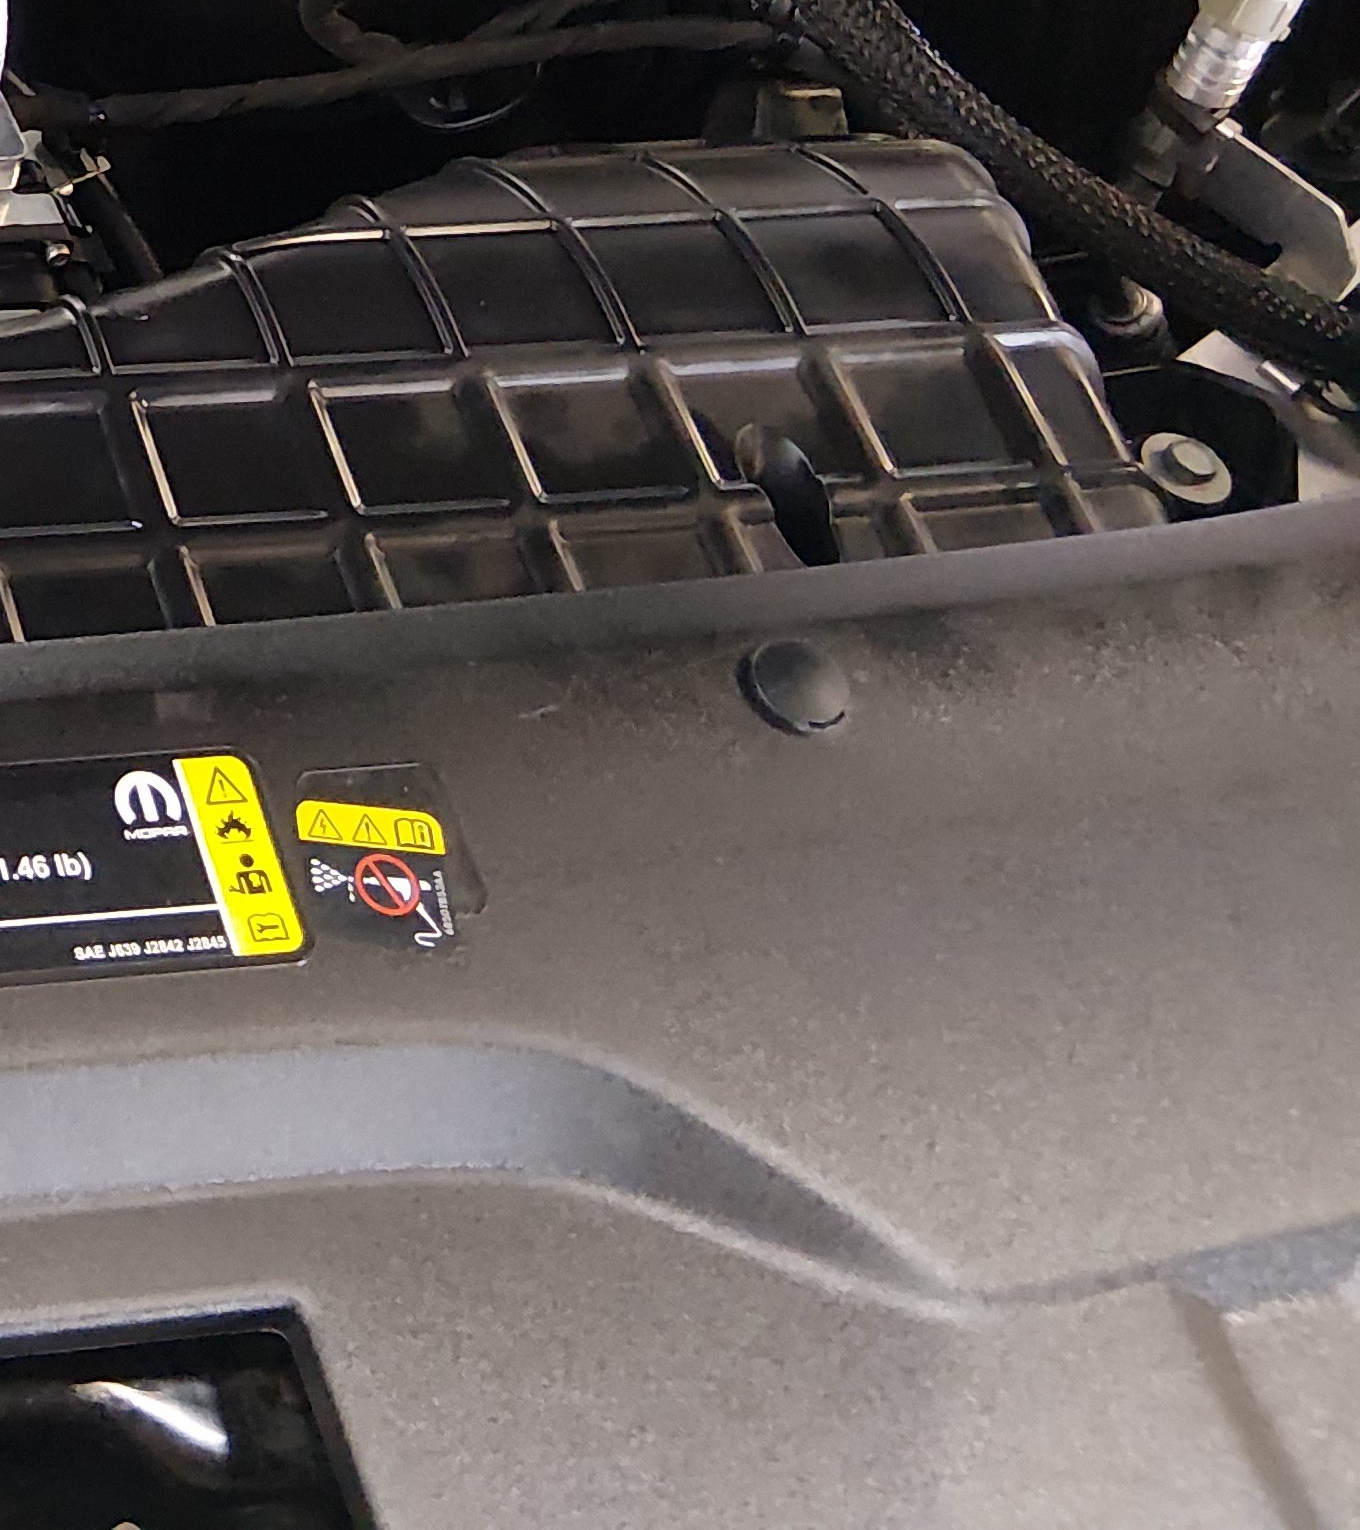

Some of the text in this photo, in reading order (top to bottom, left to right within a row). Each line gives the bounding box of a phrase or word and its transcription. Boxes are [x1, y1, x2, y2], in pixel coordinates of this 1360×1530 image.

[123, 825, 190, 841] MOPAR
[53, 851, 93, 882] lb)
[73, 944, 107, 961] SAE
[108, 941, 142, 958] J639
